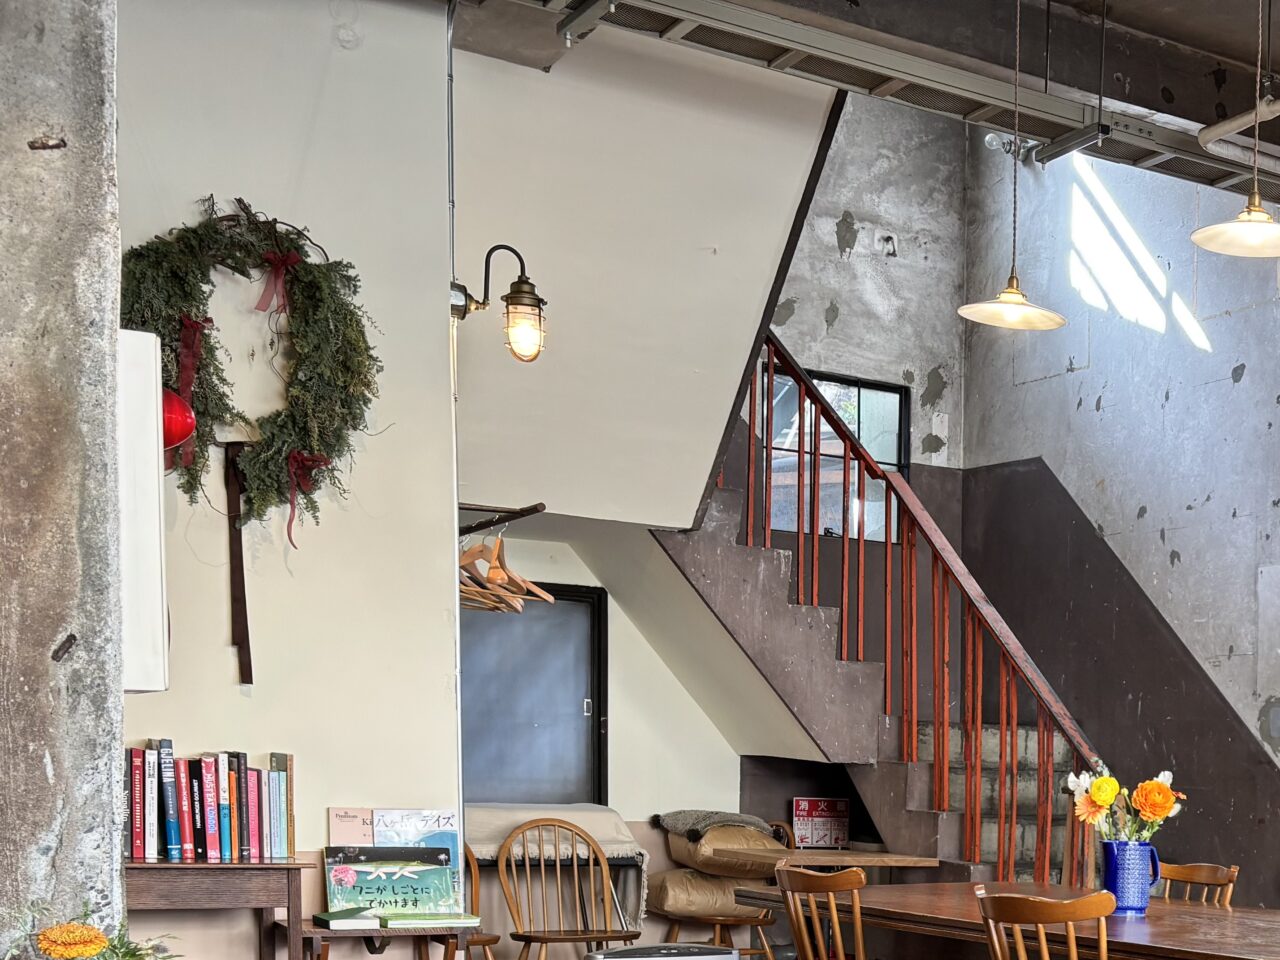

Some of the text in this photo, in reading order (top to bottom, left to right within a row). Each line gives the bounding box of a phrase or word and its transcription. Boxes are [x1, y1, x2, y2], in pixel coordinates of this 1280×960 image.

[161, 748, 176, 783] GJELINA
[205, 773, 217, 834] MUST EAT LONDON
[352, 884, 431, 895] ワニが しごとに
[365, 897, 421, 908] でかけます
